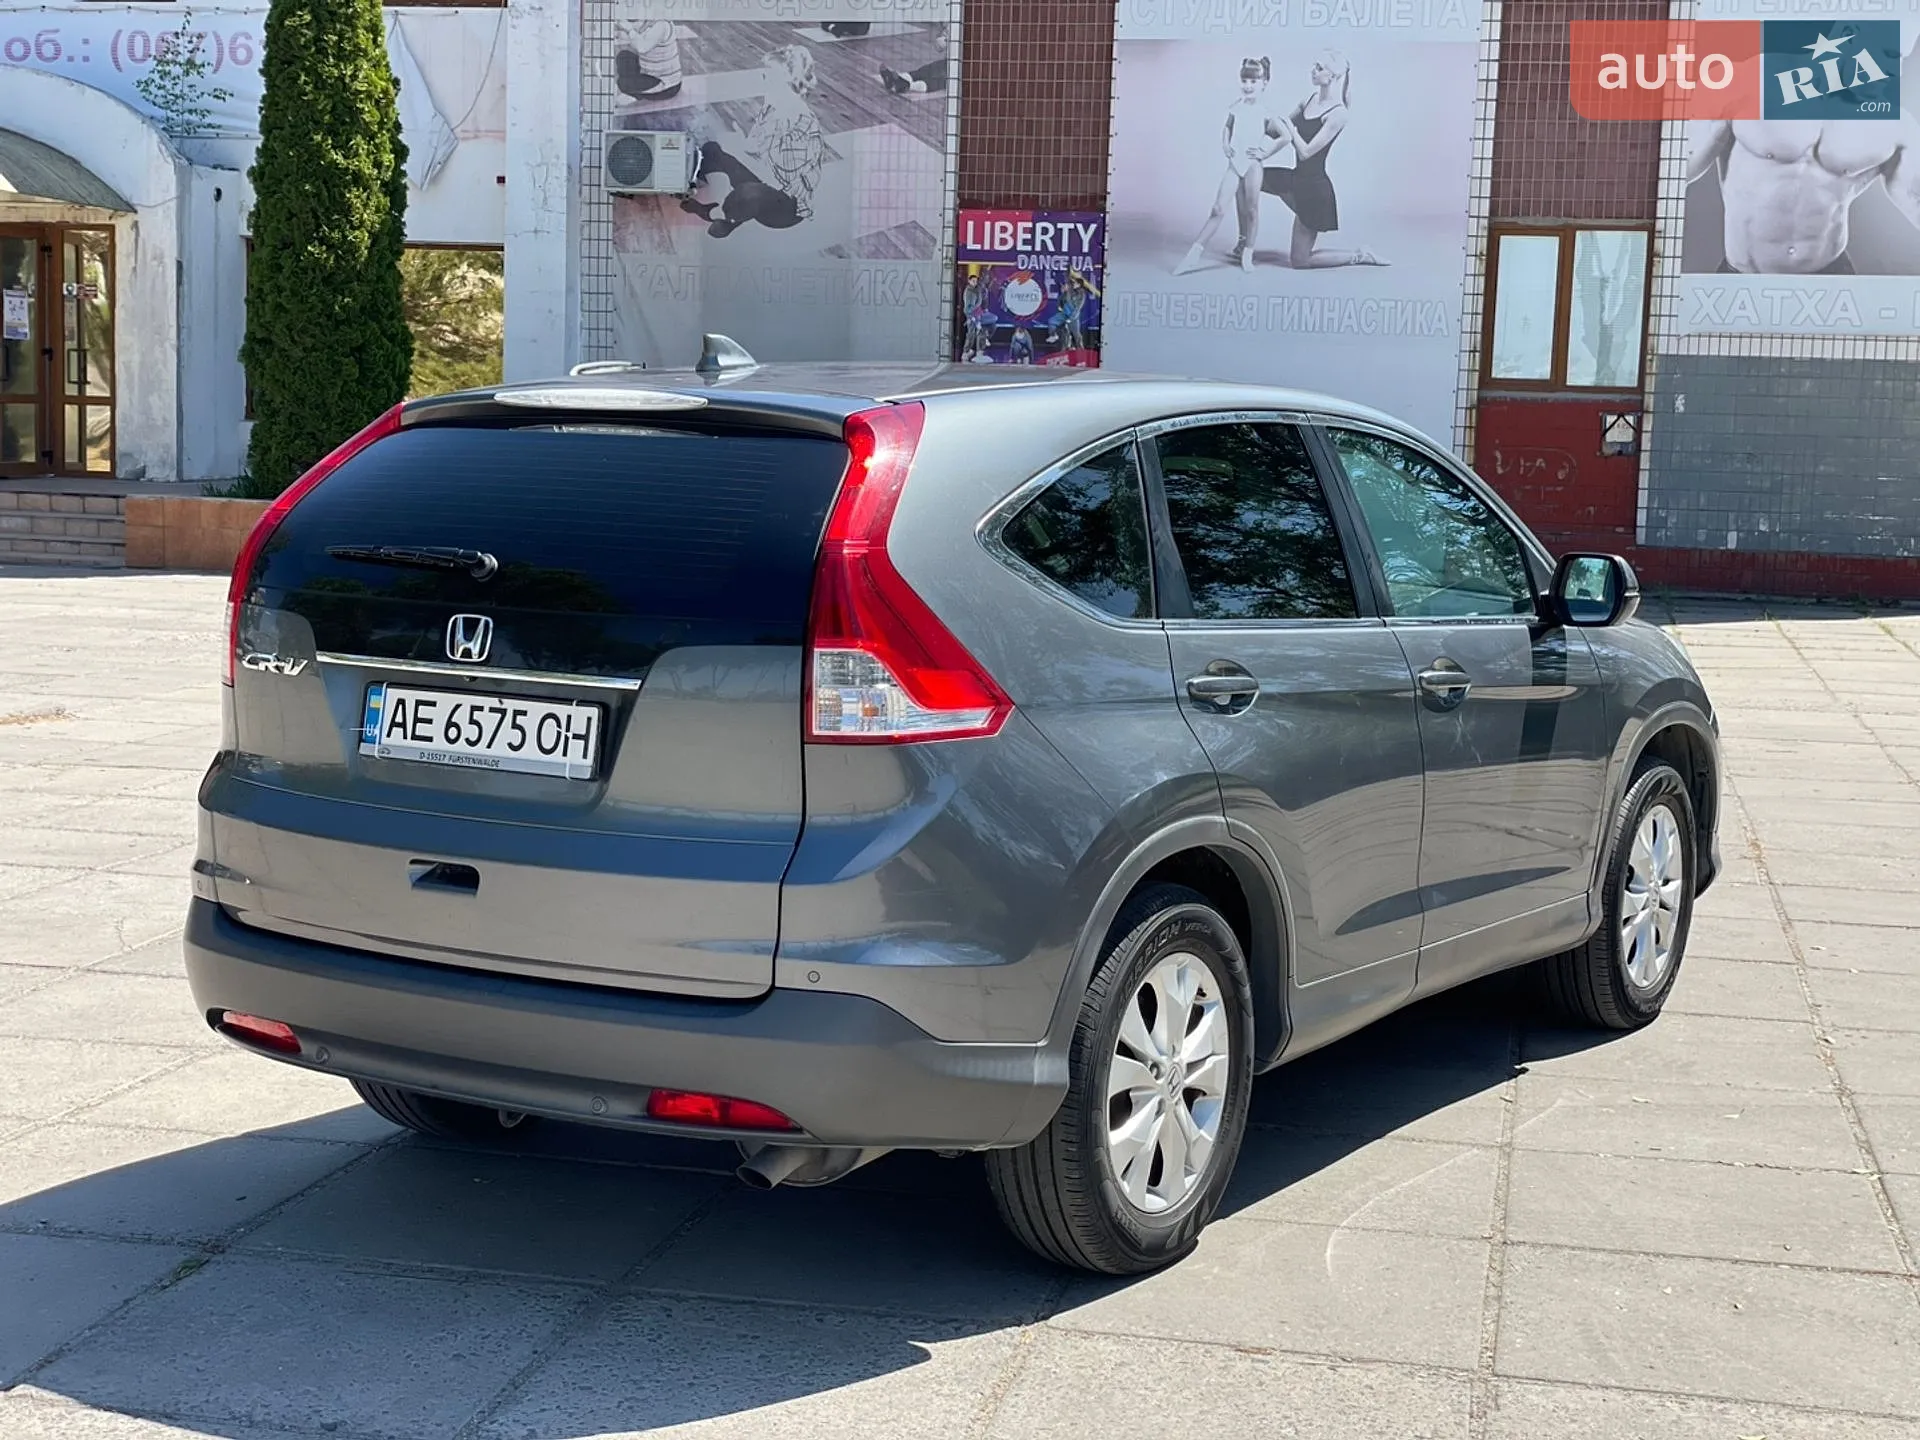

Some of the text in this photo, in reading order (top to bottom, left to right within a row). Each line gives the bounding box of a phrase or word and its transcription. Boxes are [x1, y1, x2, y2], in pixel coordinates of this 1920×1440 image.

[1129, 0, 1469, 34] СТУДИЯ БАЛЕТА
[966, 220, 1098, 253] LIBERTY
[1017, 254, 1094, 272] DANCE UA
[1113, 291, 1451, 338] ЛЕЧЕБНАЯ ГИМНАСТИКА
[1688, 287, 1863, 327] ХАТХА
[386, 697, 438, 743] AE
[443, 703, 528, 752] 6575
